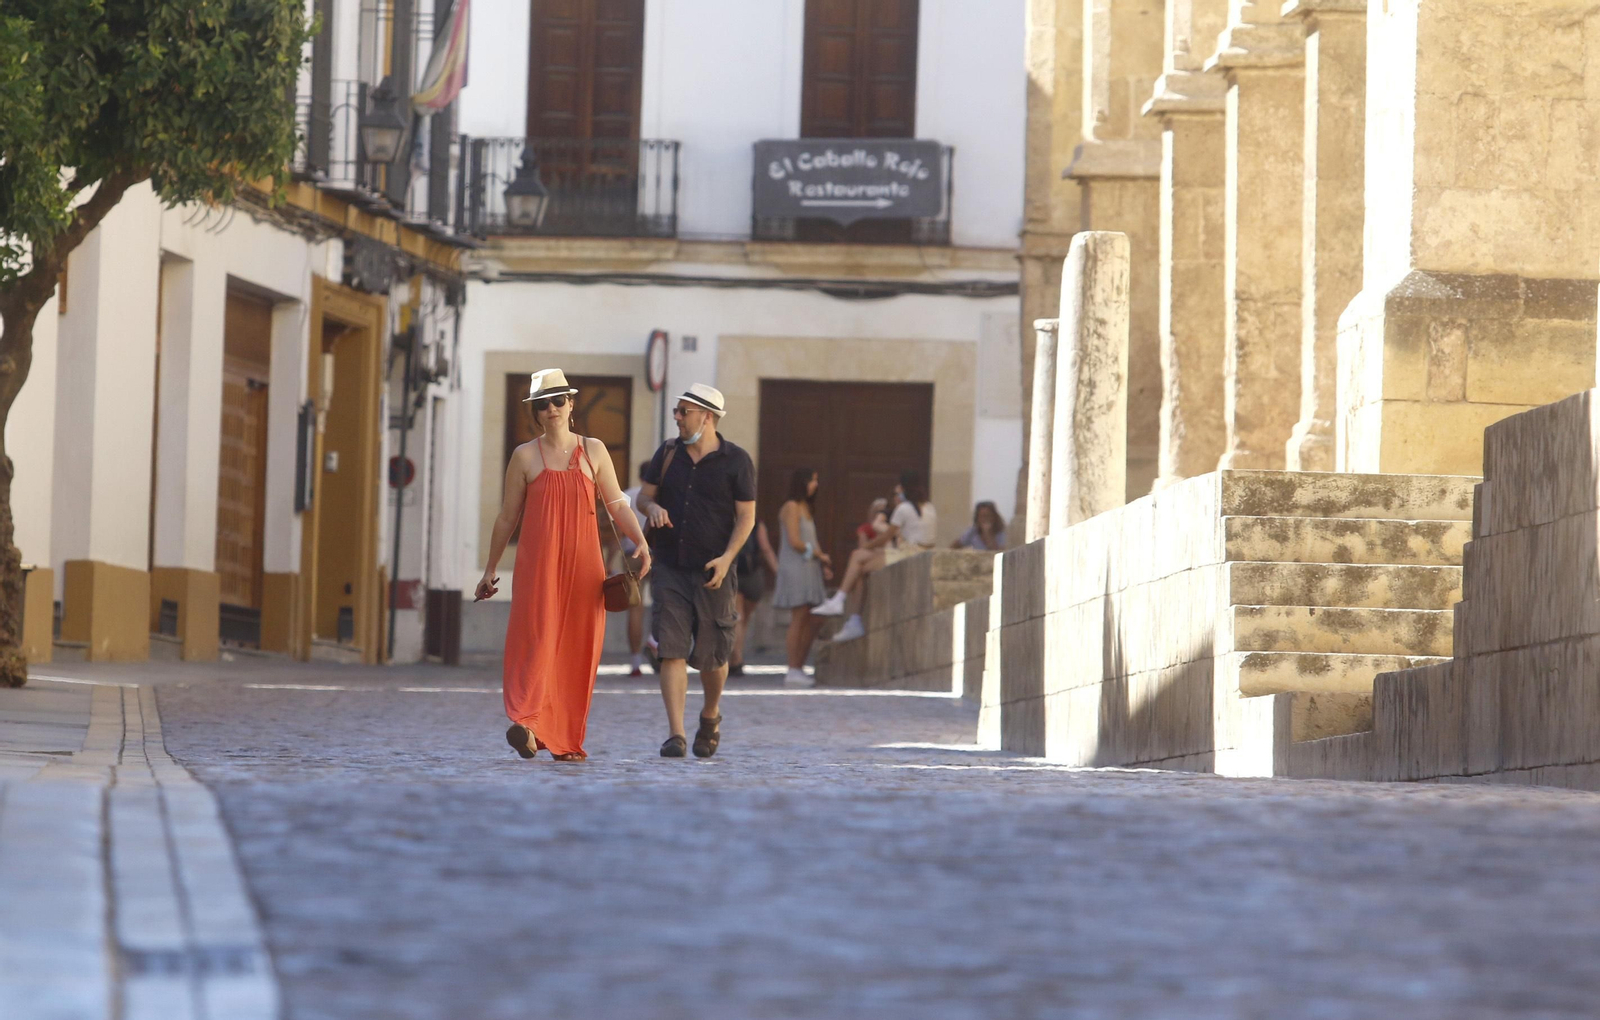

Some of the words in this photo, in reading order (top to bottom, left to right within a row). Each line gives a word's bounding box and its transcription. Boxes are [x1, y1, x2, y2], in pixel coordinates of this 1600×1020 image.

[768, 157, 794, 180] El
[797, 150, 878, 170] Caballo
[884, 151, 929, 180] Rojo
[788, 180, 910, 197] Restaurante
